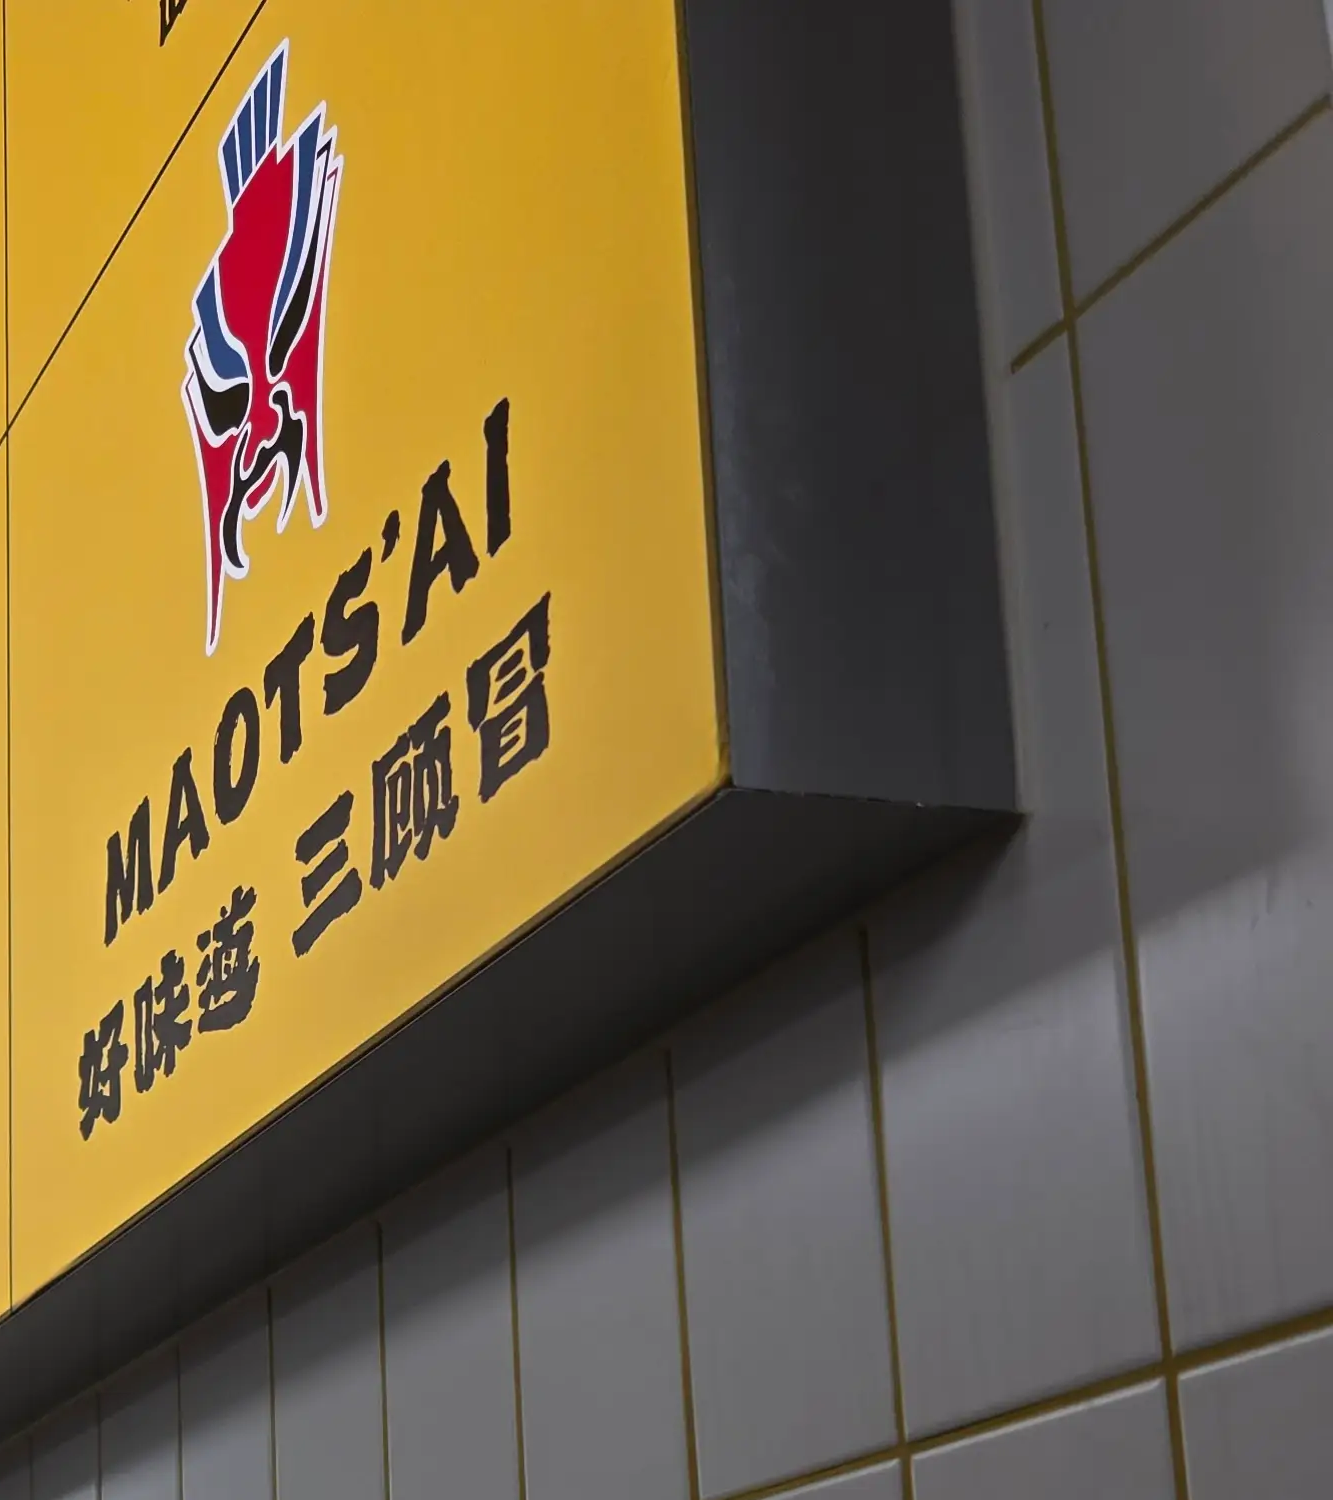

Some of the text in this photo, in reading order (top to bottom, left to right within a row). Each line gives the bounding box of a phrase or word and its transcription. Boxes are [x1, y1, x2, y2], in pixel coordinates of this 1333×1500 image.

[104, 397, 511, 946] MAOTS'AI
[292, 592, 551, 958] 三顾冒
